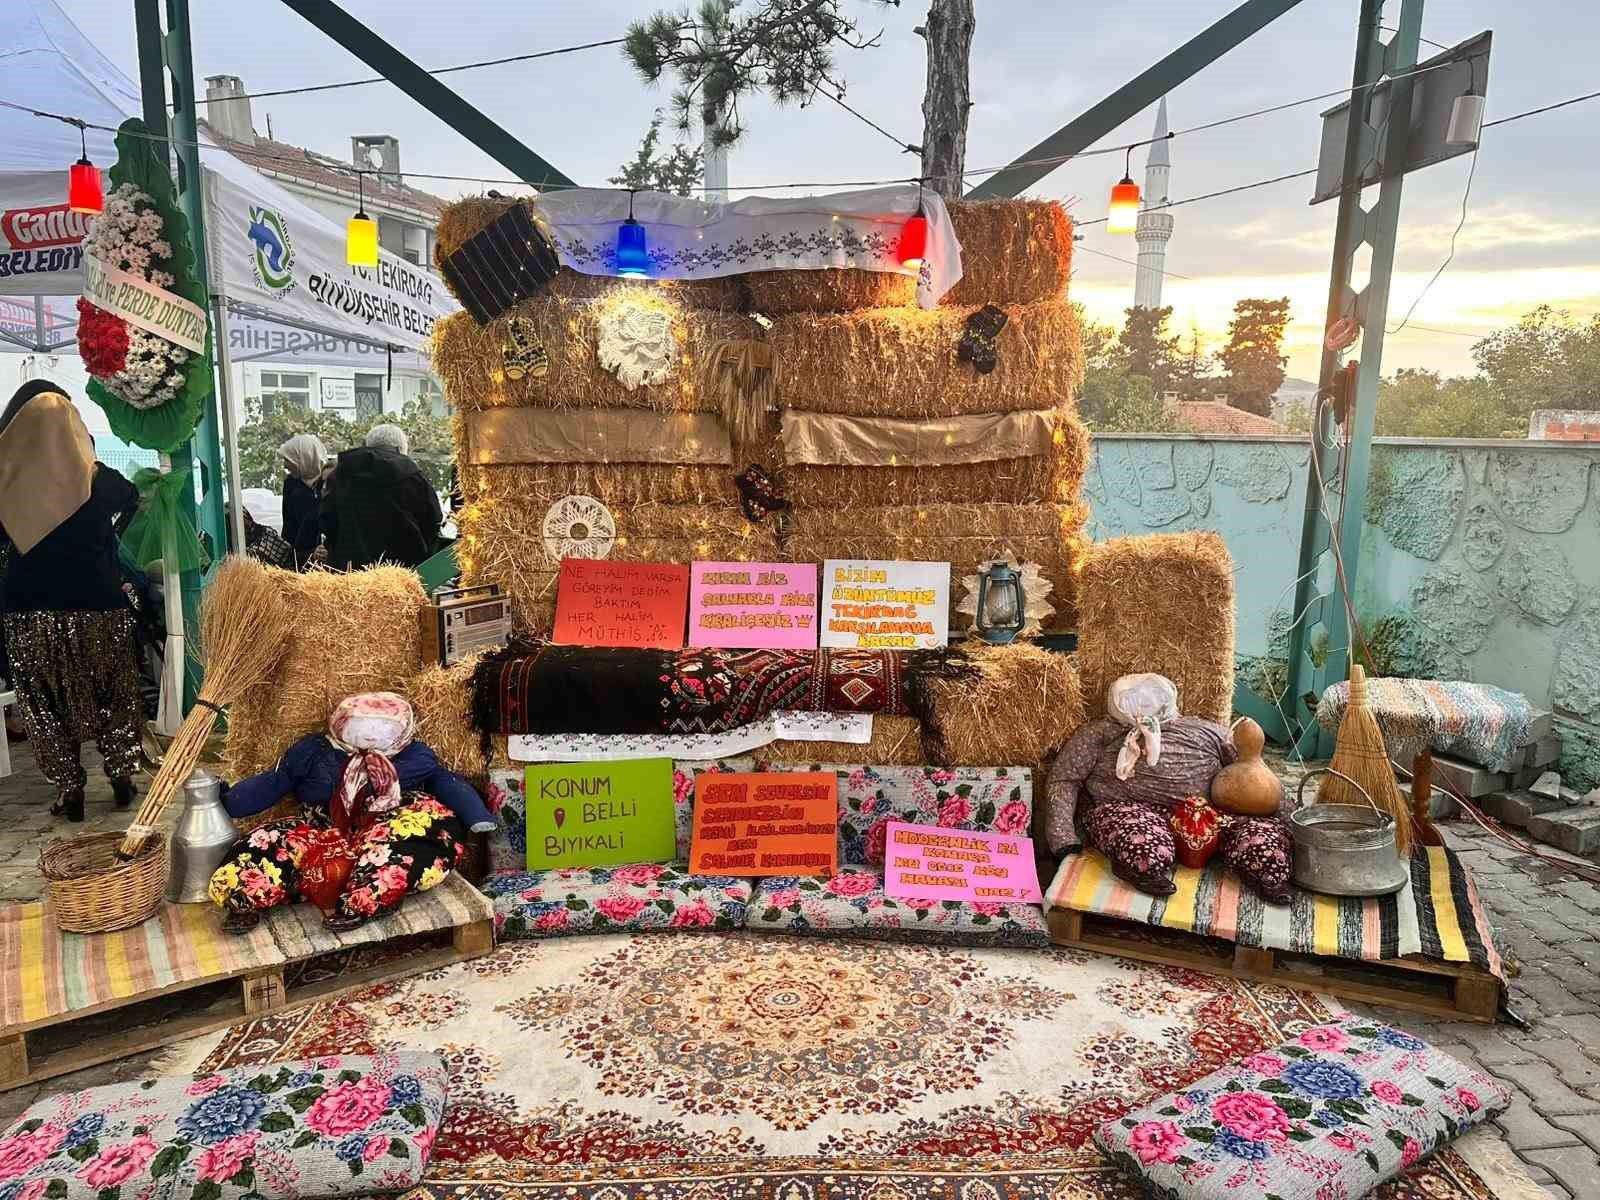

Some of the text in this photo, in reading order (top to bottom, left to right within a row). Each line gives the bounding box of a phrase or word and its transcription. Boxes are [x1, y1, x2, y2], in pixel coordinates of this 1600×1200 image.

[115, 282, 161, 321] PERDE
[308, 272, 402, 325] BÜYÜKŞEHİR
[565, 566, 585, 579] NE
[834, 564, 888, 584] BİZİM
[593, 596, 641, 609] BAKTIM
[567, 611, 597, 624] HER
[539, 775, 612, 800] KONUM
[582, 798, 637, 824] BELLİ
[544, 831, 625, 857] BIYIKALİ
[894, 830, 992, 853] MODERNLİK
